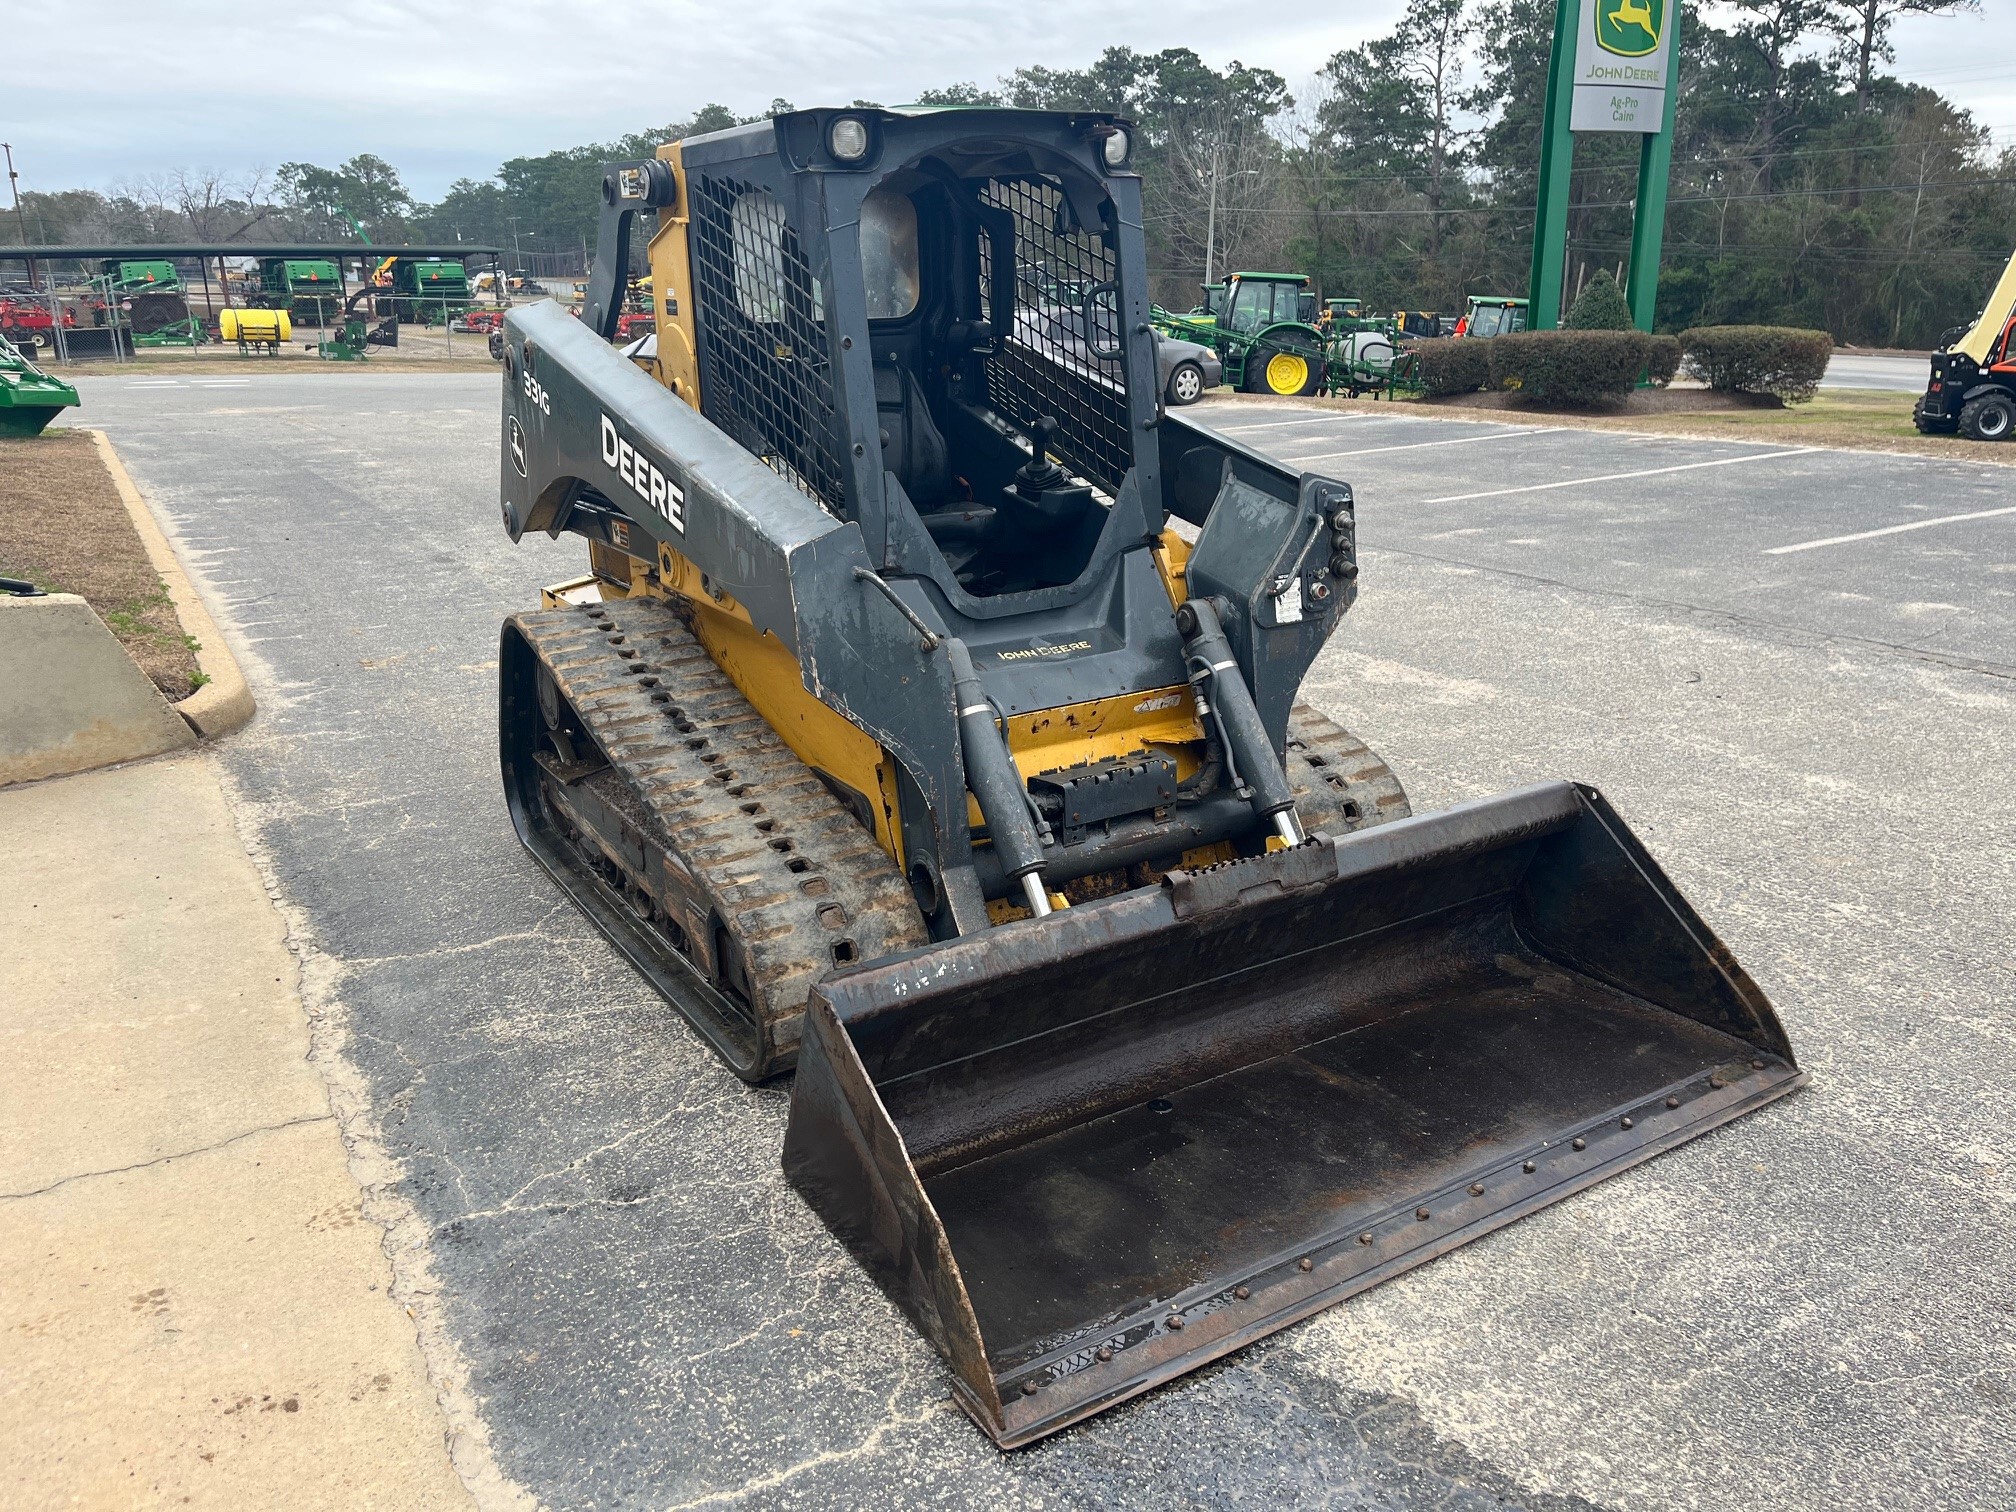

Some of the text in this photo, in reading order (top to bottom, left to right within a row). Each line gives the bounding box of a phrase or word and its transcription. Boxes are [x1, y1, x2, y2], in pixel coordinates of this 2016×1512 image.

[1586, 64, 1660, 81] JOHN DEERE
[1610, 96, 1638, 109] Ag-Pro
[1612, 110, 1634, 122] Cairo
[523, 370, 551, 416] 331G
[601, 412, 685, 534] DEERE
[1036, 640, 1092, 656] DEERE
